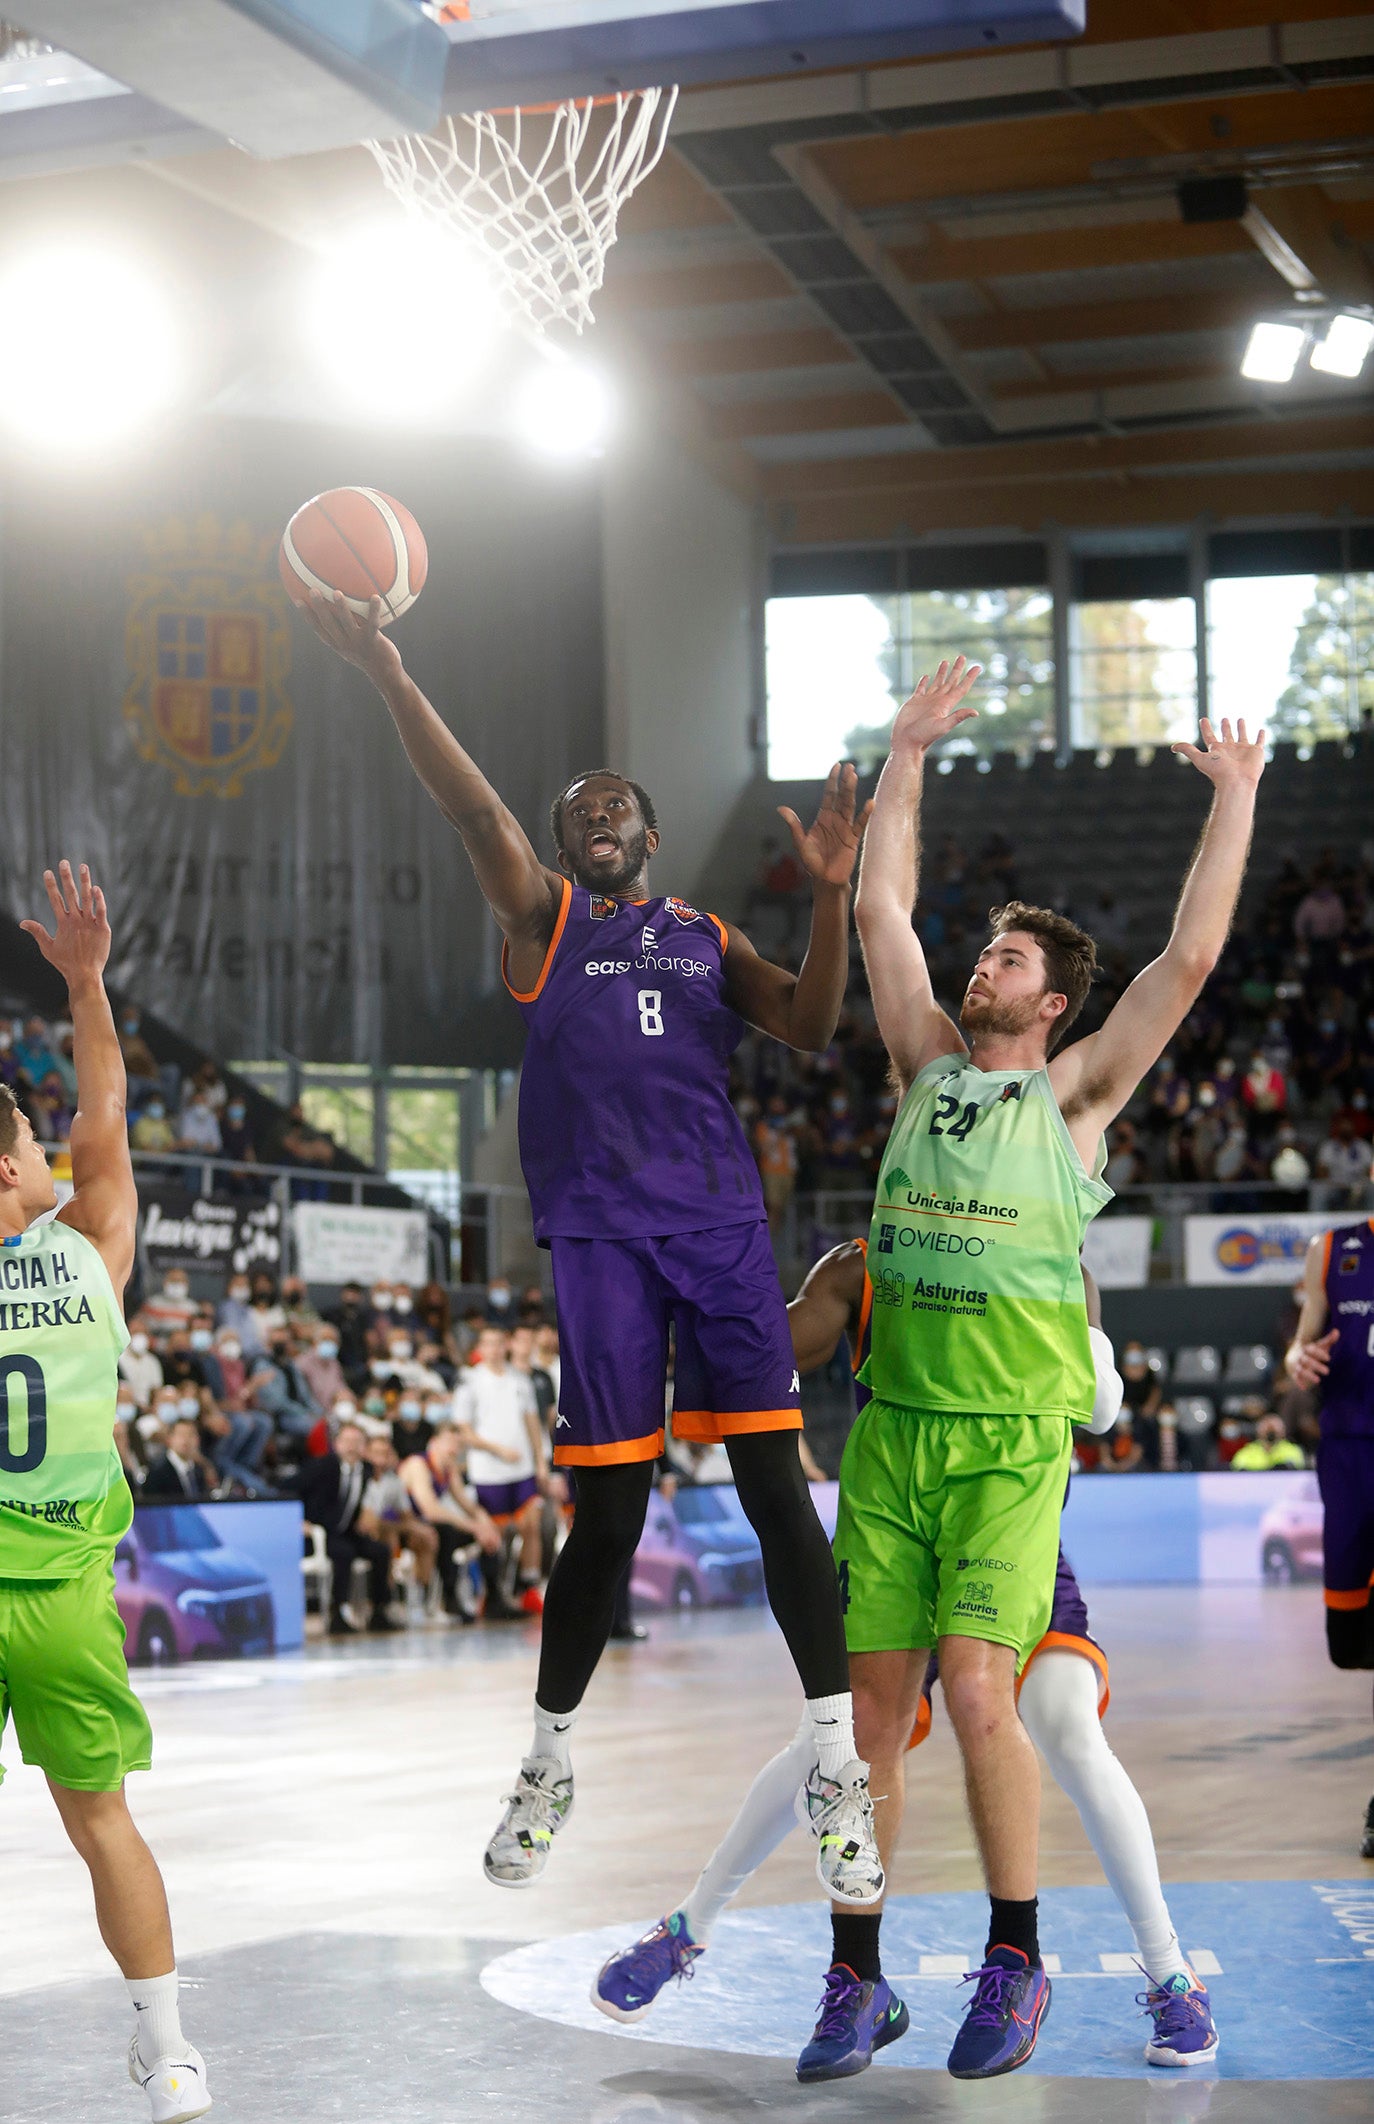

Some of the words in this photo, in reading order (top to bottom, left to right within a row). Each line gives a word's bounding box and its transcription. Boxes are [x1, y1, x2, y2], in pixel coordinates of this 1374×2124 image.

[637, 989, 664, 1036] 8
[928, 1093, 981, 1142] 24
[906, 1191, 965, 1215] Unicaja
[967, 1199, 1019, 1219] Banco
[0, 1257, 47, 1291] CIA
[51, 1252, 79, 1285] H.
[912, 1277, 989, 1304] Asturias
[0, 1294, 96, 1331] ERKA
[949, 1304, 987, 1317] natural
[953, 1599, 999, 1616] Asturias
